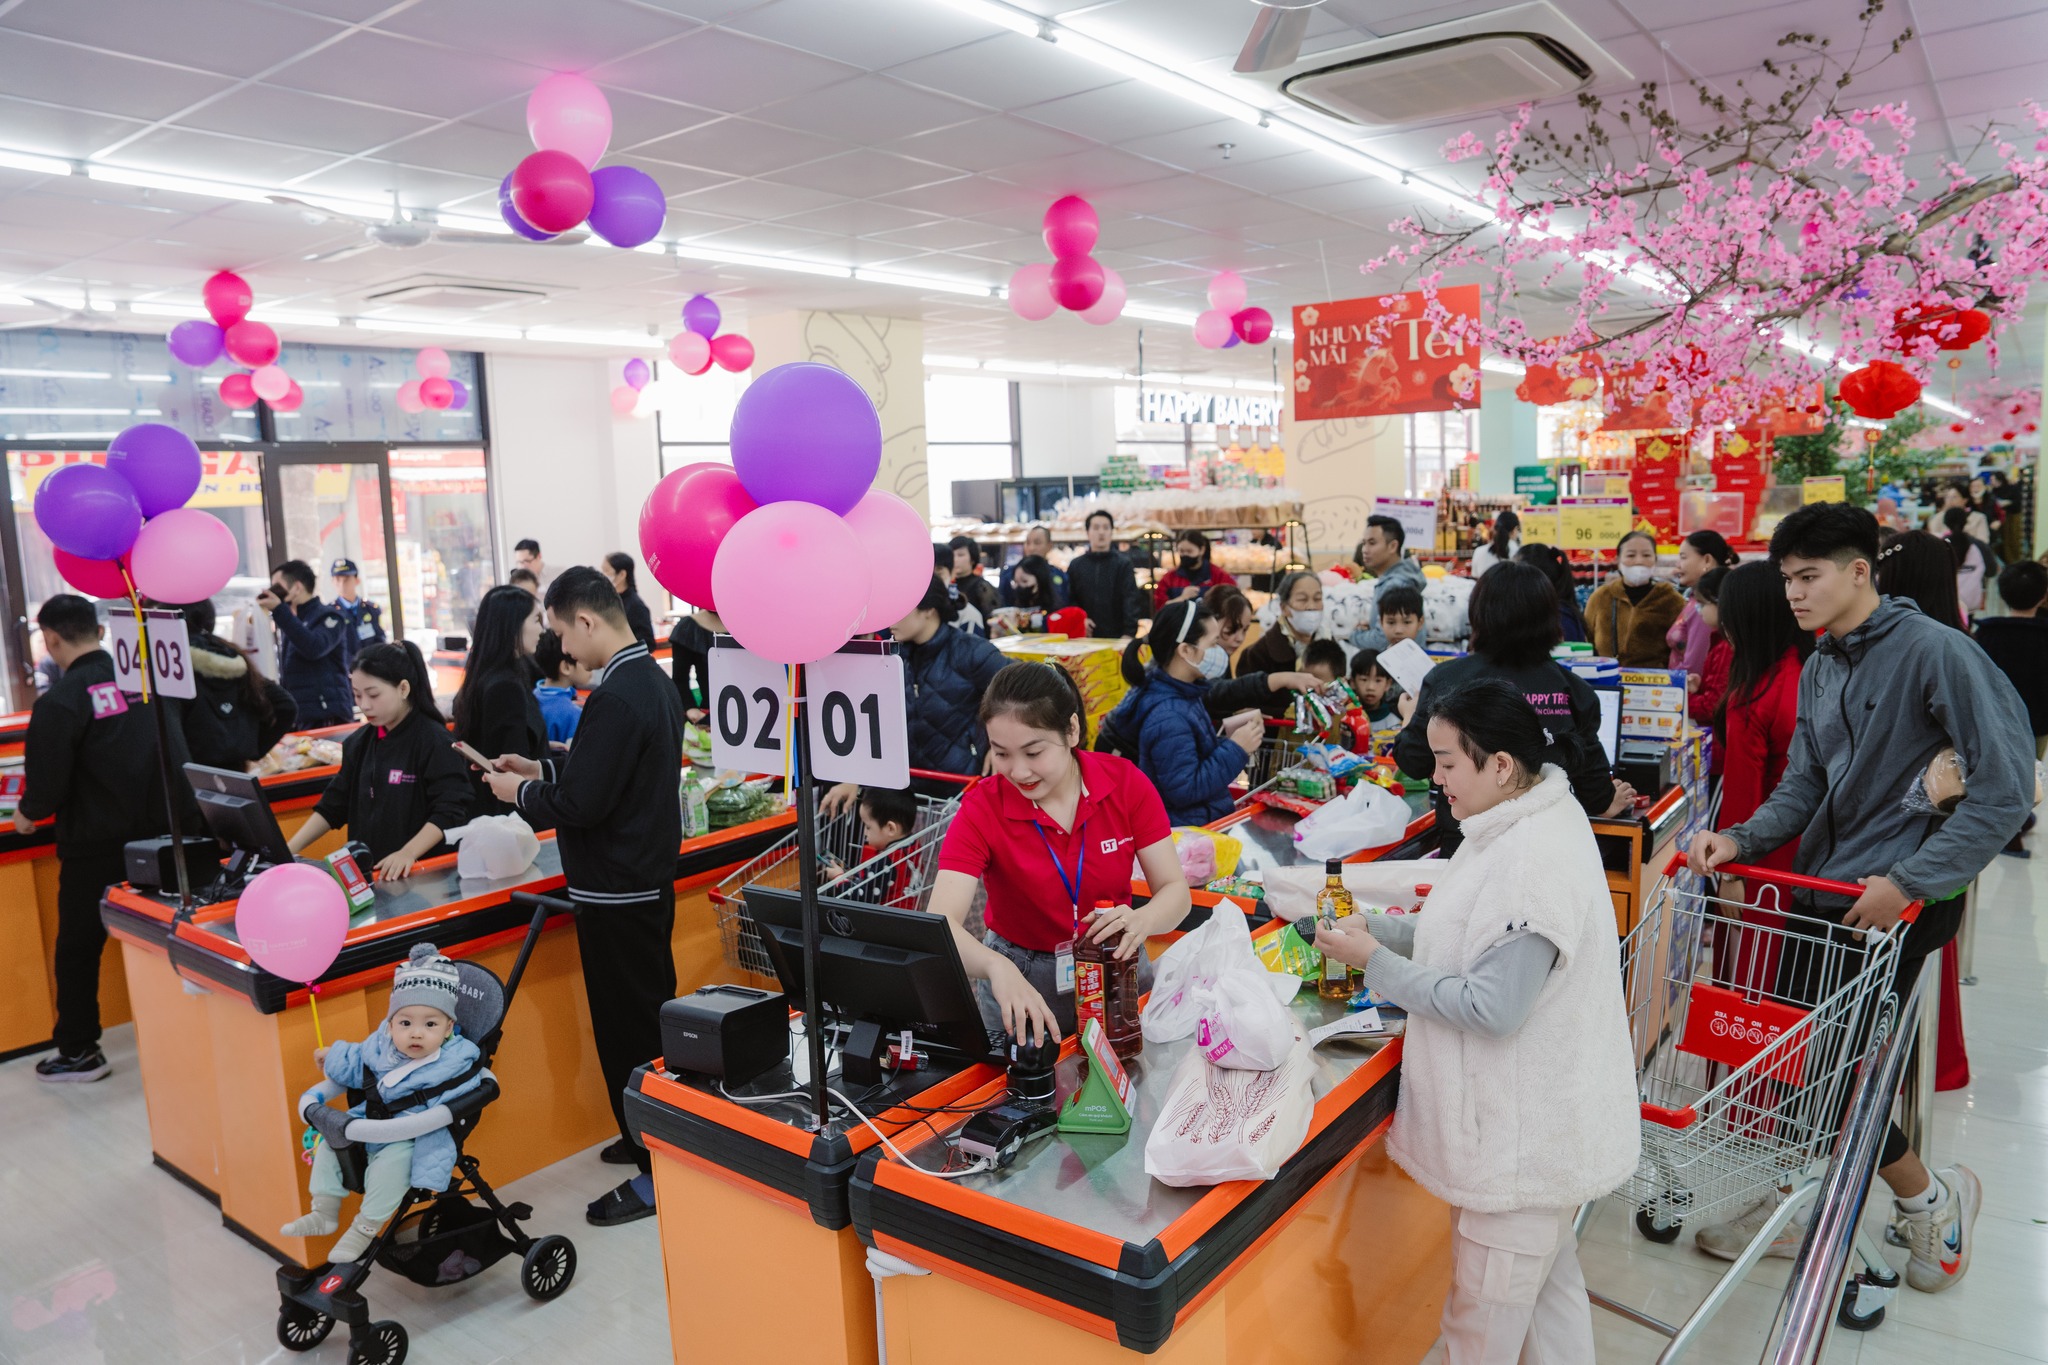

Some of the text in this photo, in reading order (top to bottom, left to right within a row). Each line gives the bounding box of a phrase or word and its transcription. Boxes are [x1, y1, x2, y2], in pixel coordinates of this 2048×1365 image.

[1142, 388, 1283, 426] HAPPY BAKERY
[1575, 527, 1592, 540] 96
[155, 639, 184, 681] 03
[1522, 692, 1550, 705] APPY
[717, 684, 781, 751] 02
[821, 690, 882, 760] 01
[1714, 1010, 1780, 1033] NO NO NO YES
[682, 1031, 699, 1040] EPSON
[326, 1277, 340, 1289] V
